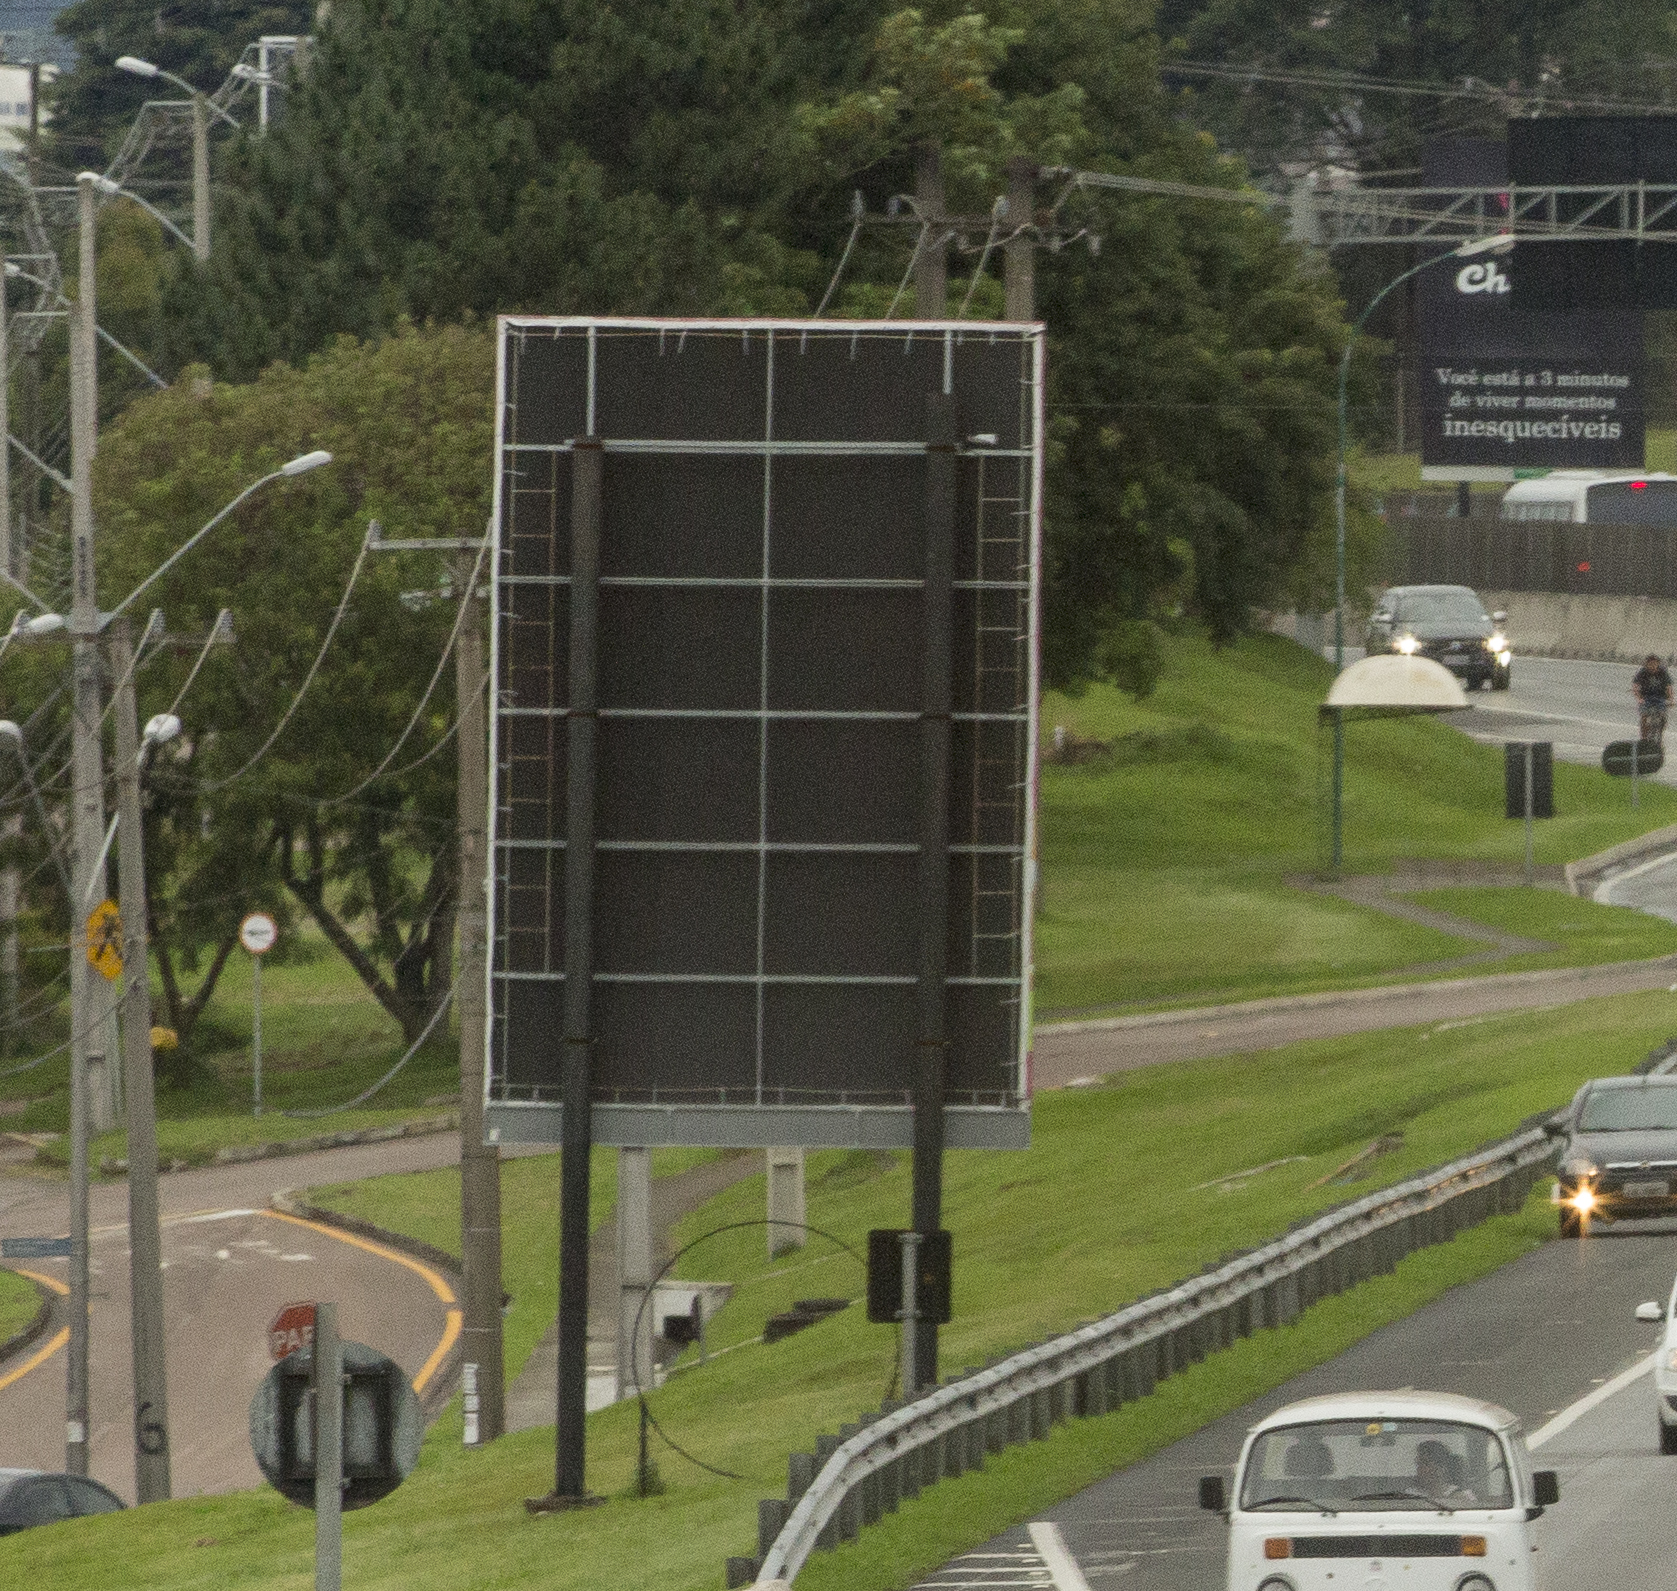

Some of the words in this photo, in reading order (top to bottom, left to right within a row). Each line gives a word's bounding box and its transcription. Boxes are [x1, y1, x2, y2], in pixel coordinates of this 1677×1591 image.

[1436, 368, 1478, 385] Você
[1541, 371, 1553, 387] 3
[1556, 370, 1629, 388] minutos
[1450, 391, 1471, 408] de
[1476, 391, 1520, 408] viver
[1525, 393, 1617, 409] momentos
[1443, 413, 1623, 443] inesquecíveis
